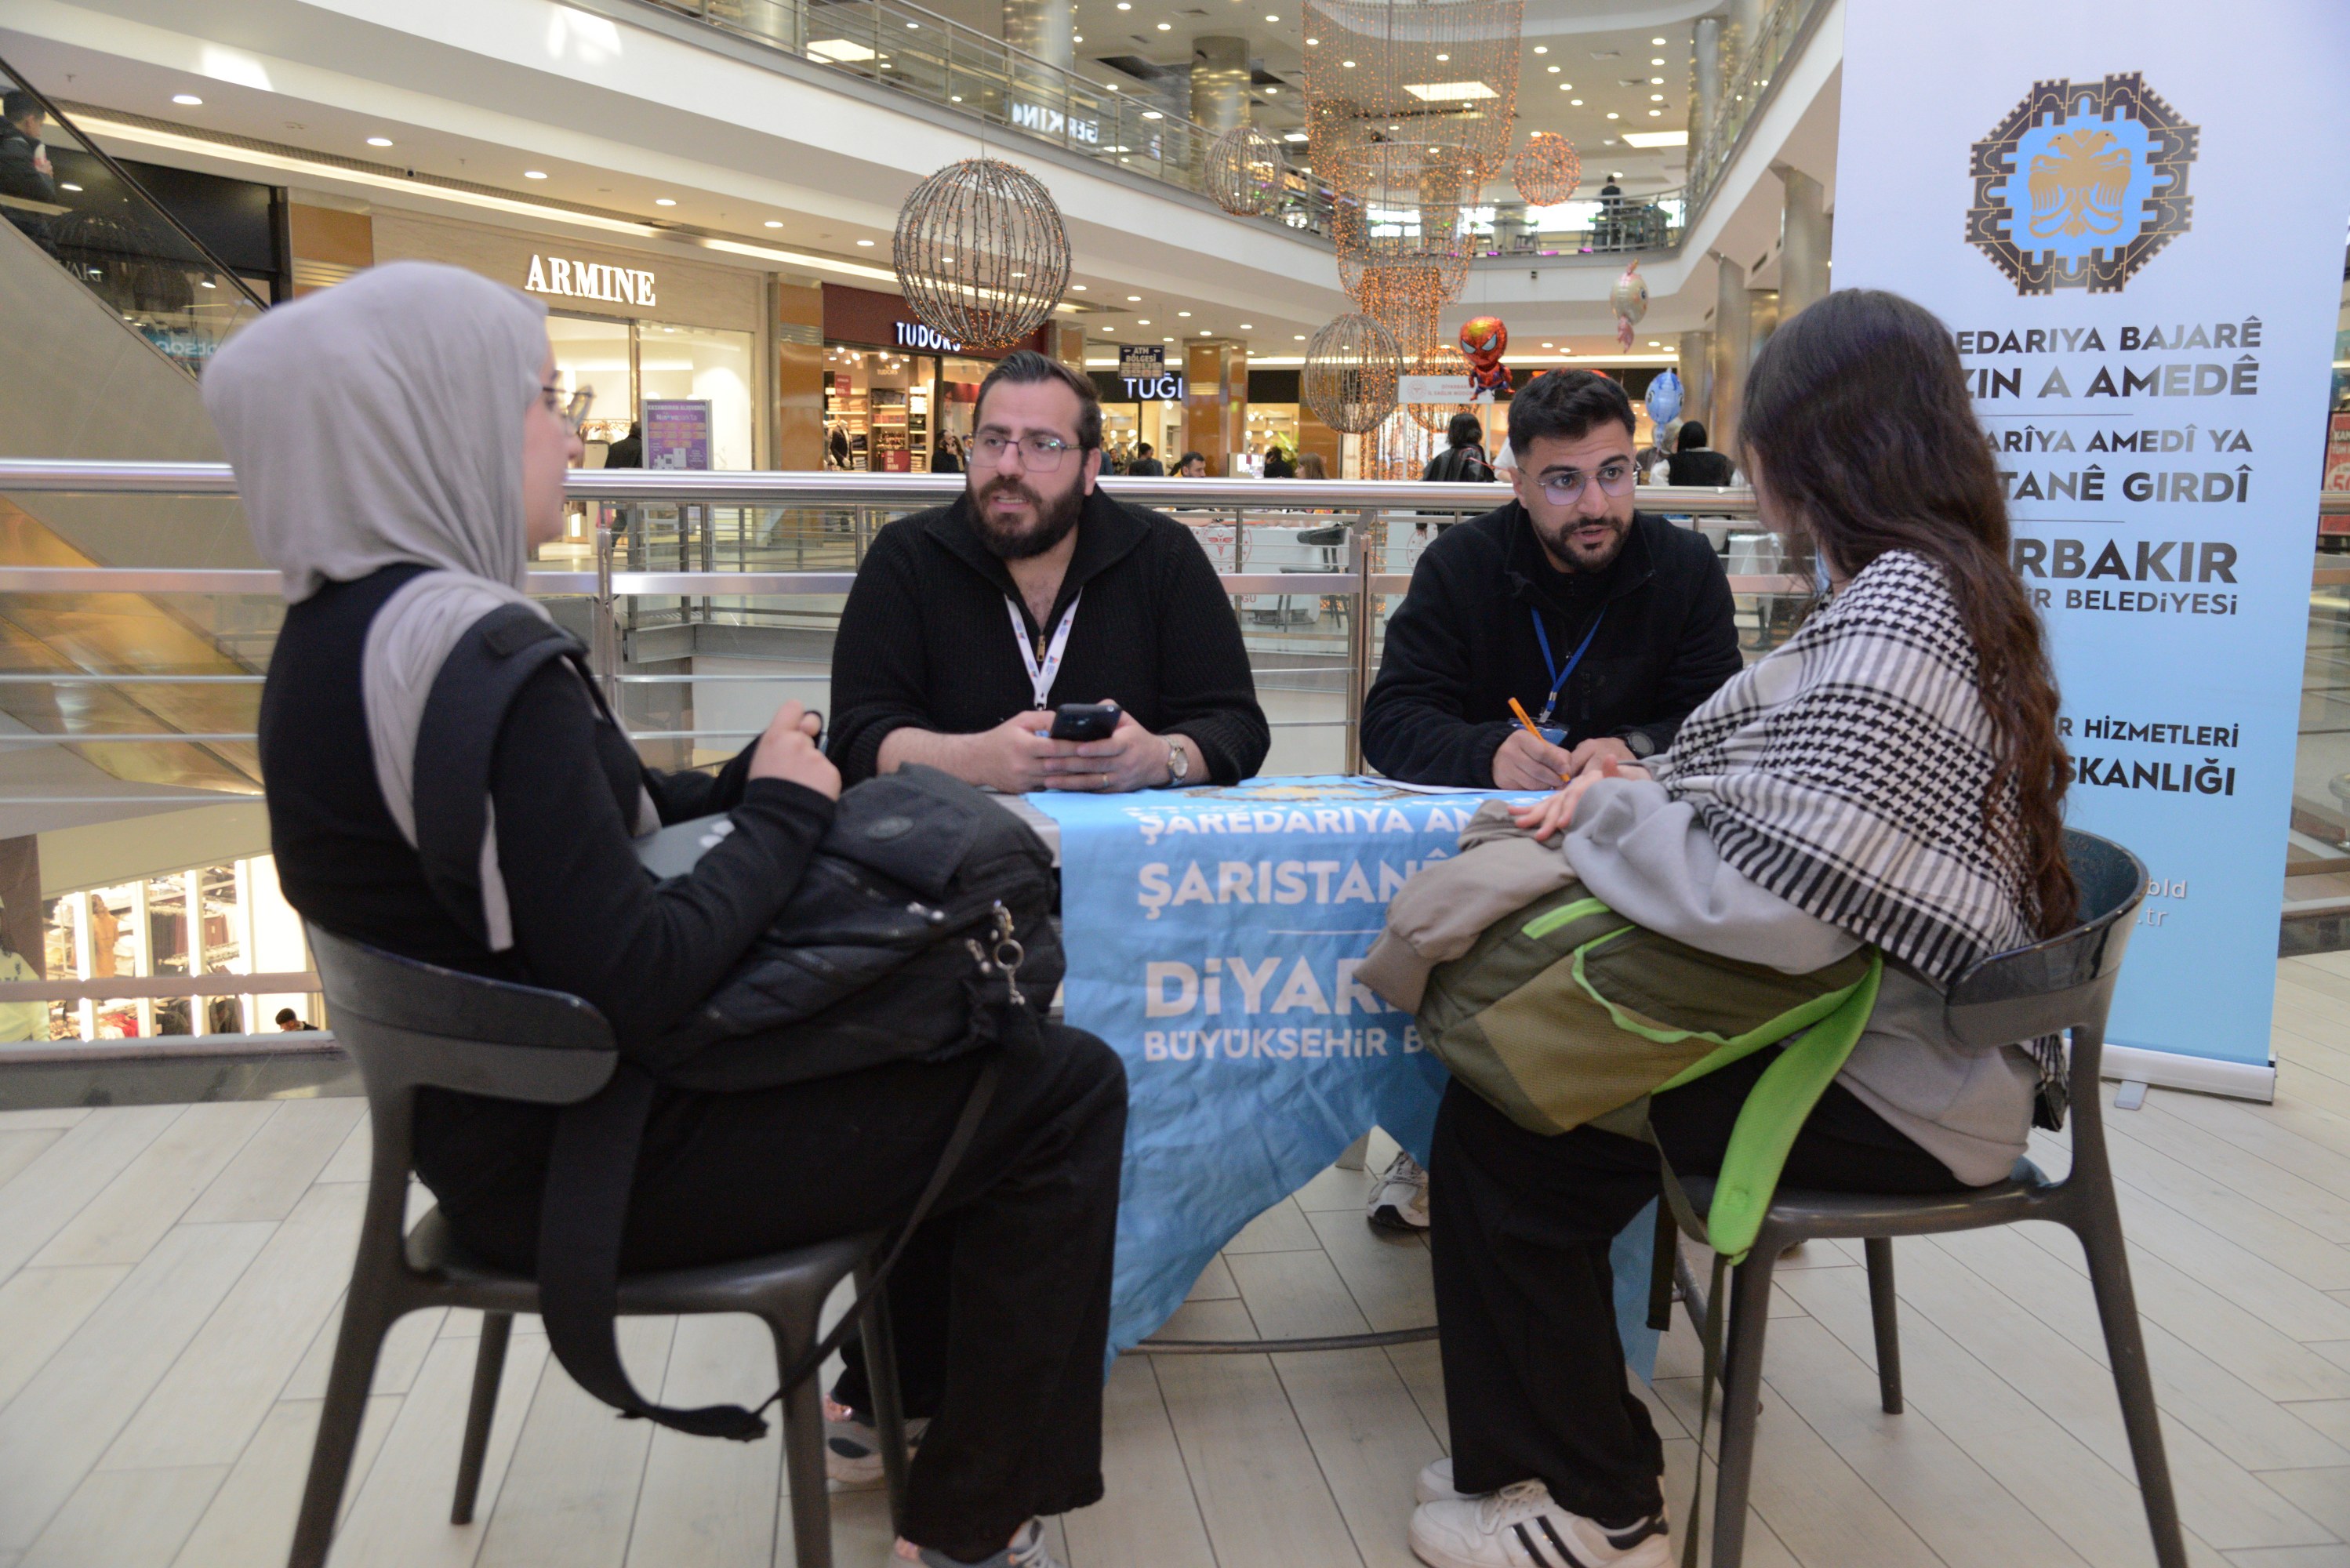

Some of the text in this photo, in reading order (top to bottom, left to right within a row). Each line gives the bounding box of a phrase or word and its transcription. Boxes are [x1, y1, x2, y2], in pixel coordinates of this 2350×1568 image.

[525, 254, 656, 307] ARMINE
[1956, 315, 2262, 354] EDARIYA BAJARÊ
[1125, 354, 1157, 362] BÖLGESİ
[2037, 365, 2072, 398] A
[2084, 354, 2259, 397] AMEDÊ
[2085, 423, 2198, 452] AMEDÎ
[2208, 429, 2253, 452] YA
[2123, 463, 2254, 503] GIRDÎ
[2013, 538, 2238, 583] RBAKIR
[2084, 715, 2239, 748] HİZMETLERİ
